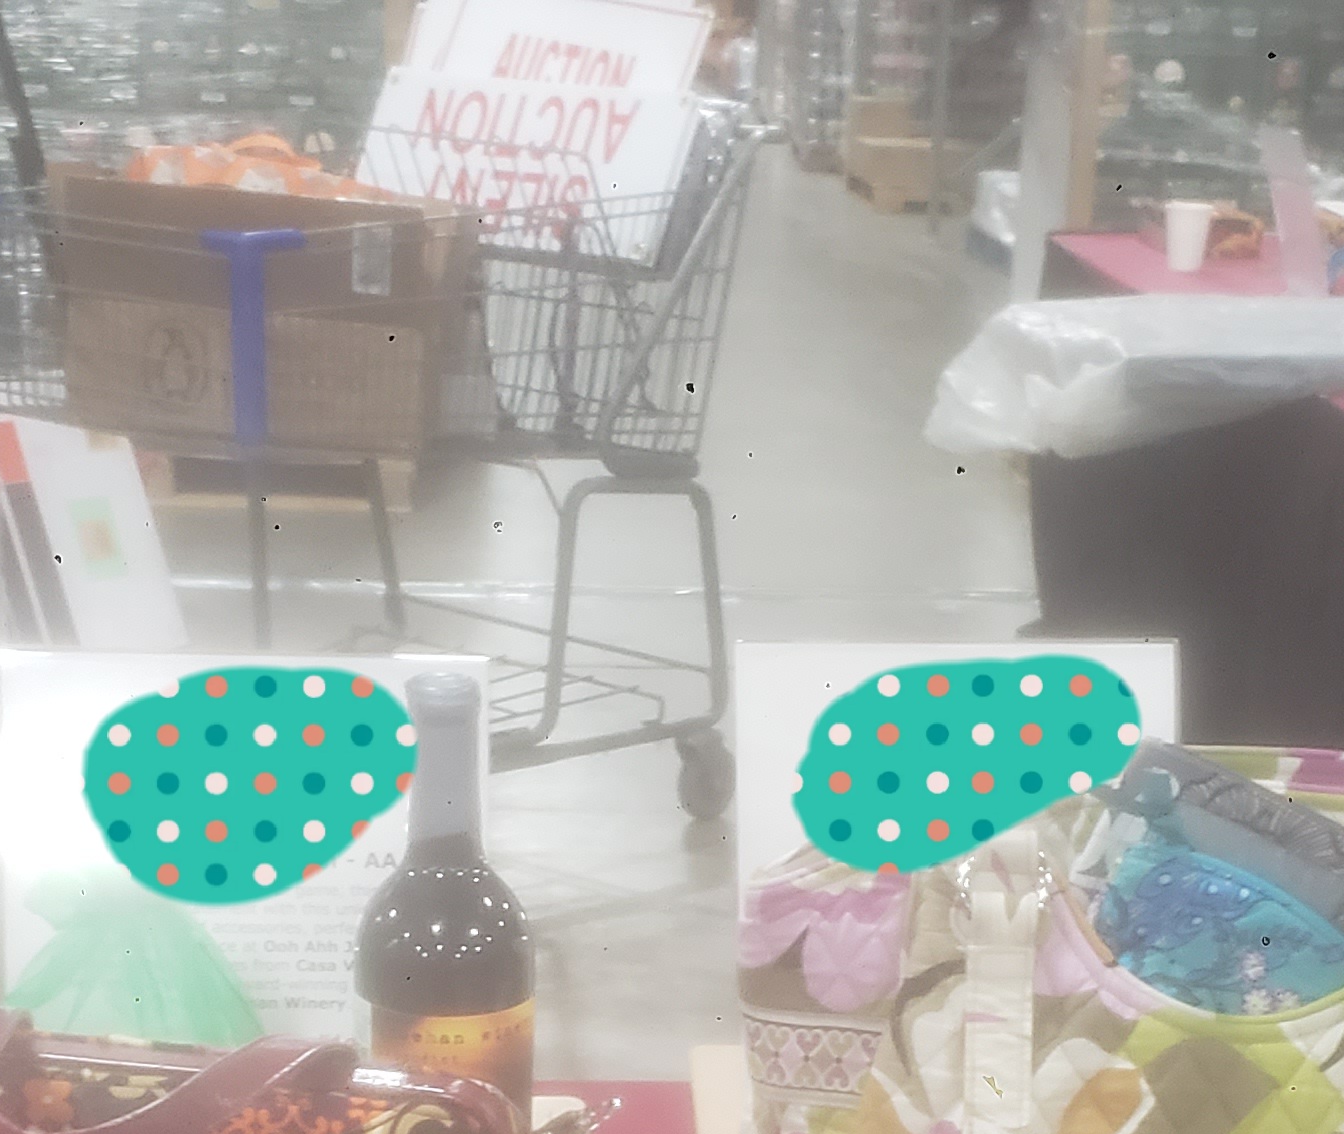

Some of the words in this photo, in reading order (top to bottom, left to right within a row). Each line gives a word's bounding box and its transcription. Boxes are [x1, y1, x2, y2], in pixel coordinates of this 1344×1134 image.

[408, 88, 642, 164] AUCTION
[296, 958, 336, 972] Casa
[284, 996, 347, 1012] Winery
